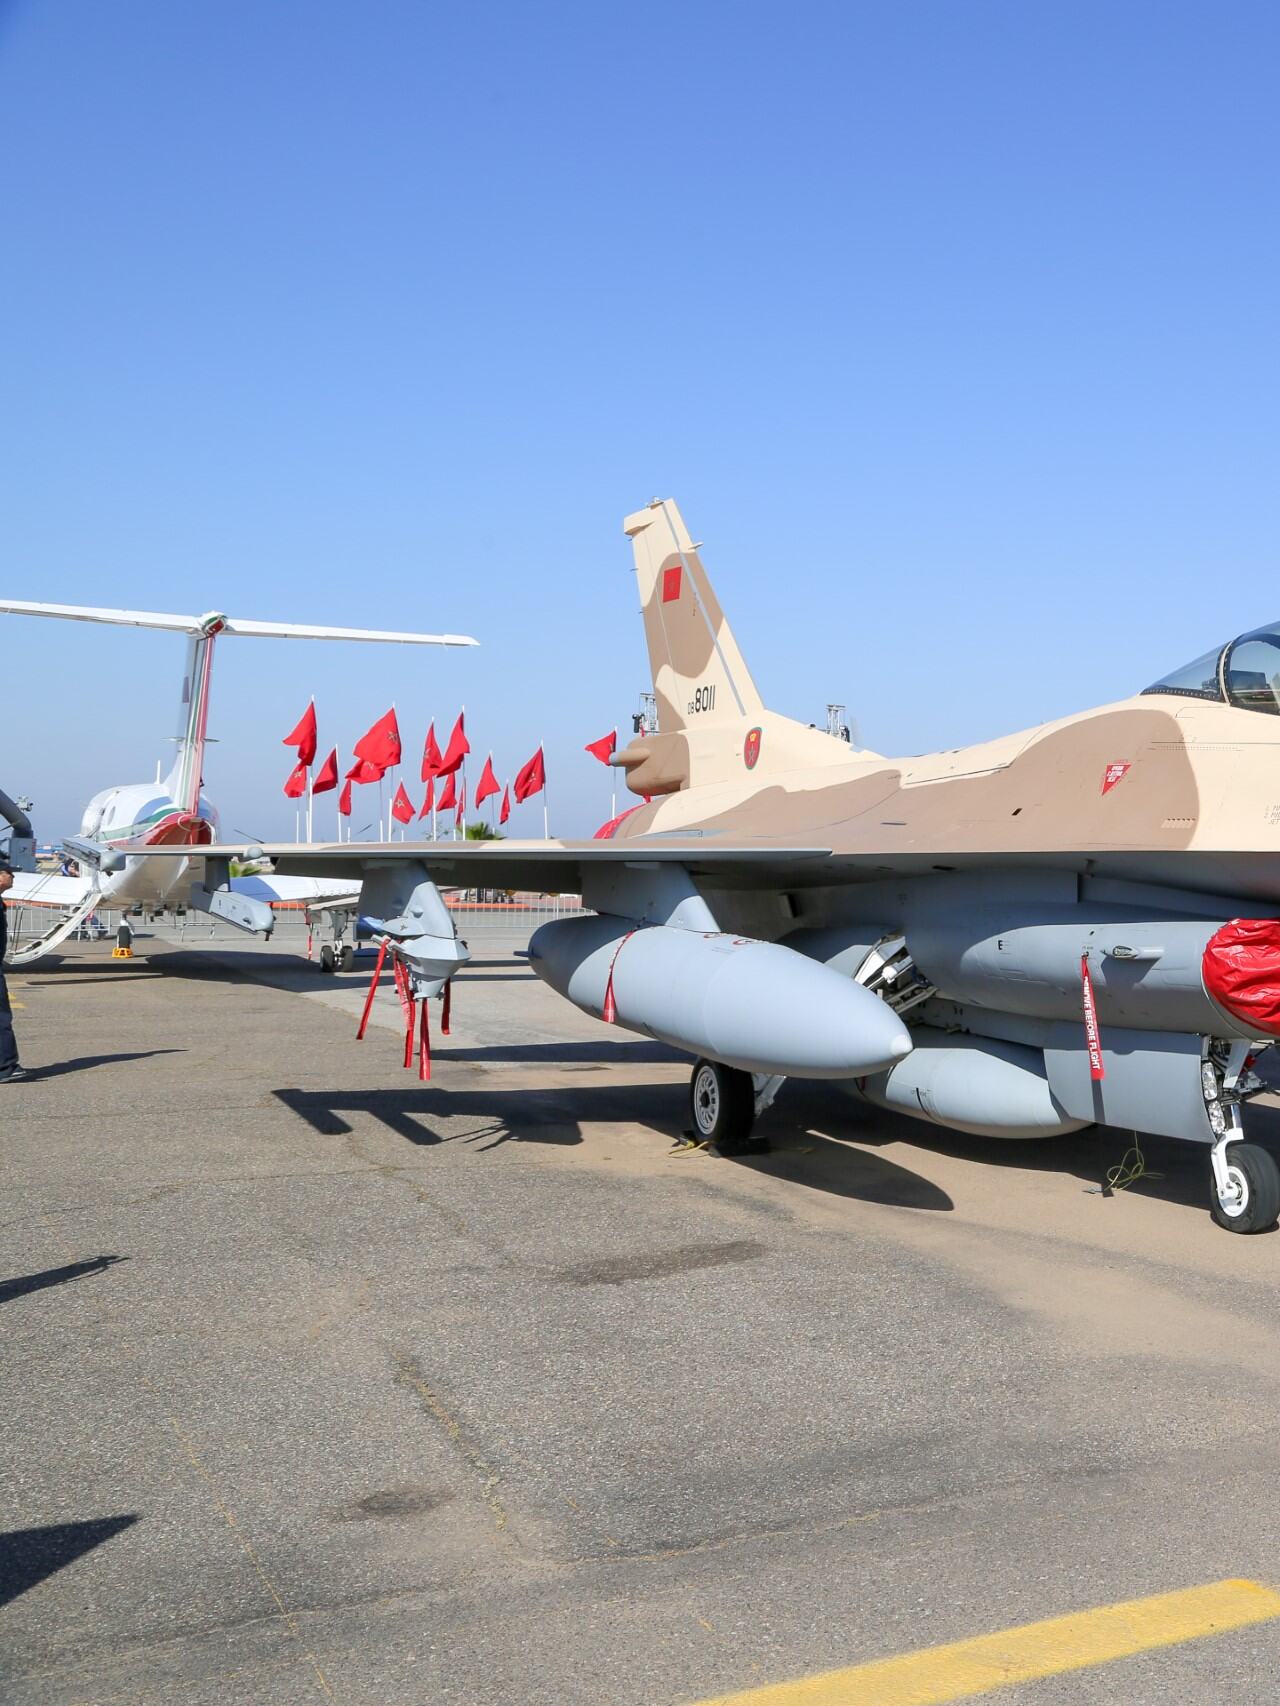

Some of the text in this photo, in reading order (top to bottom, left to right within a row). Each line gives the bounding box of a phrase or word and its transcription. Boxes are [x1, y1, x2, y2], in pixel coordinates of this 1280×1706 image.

[694, 684, 716, 712] 8011
[998, 940, 1003, 950] E
[1085, 1010, 1096, 1041] BEFORE
[1088, 1042, 1101, 1070] FLIGHT
